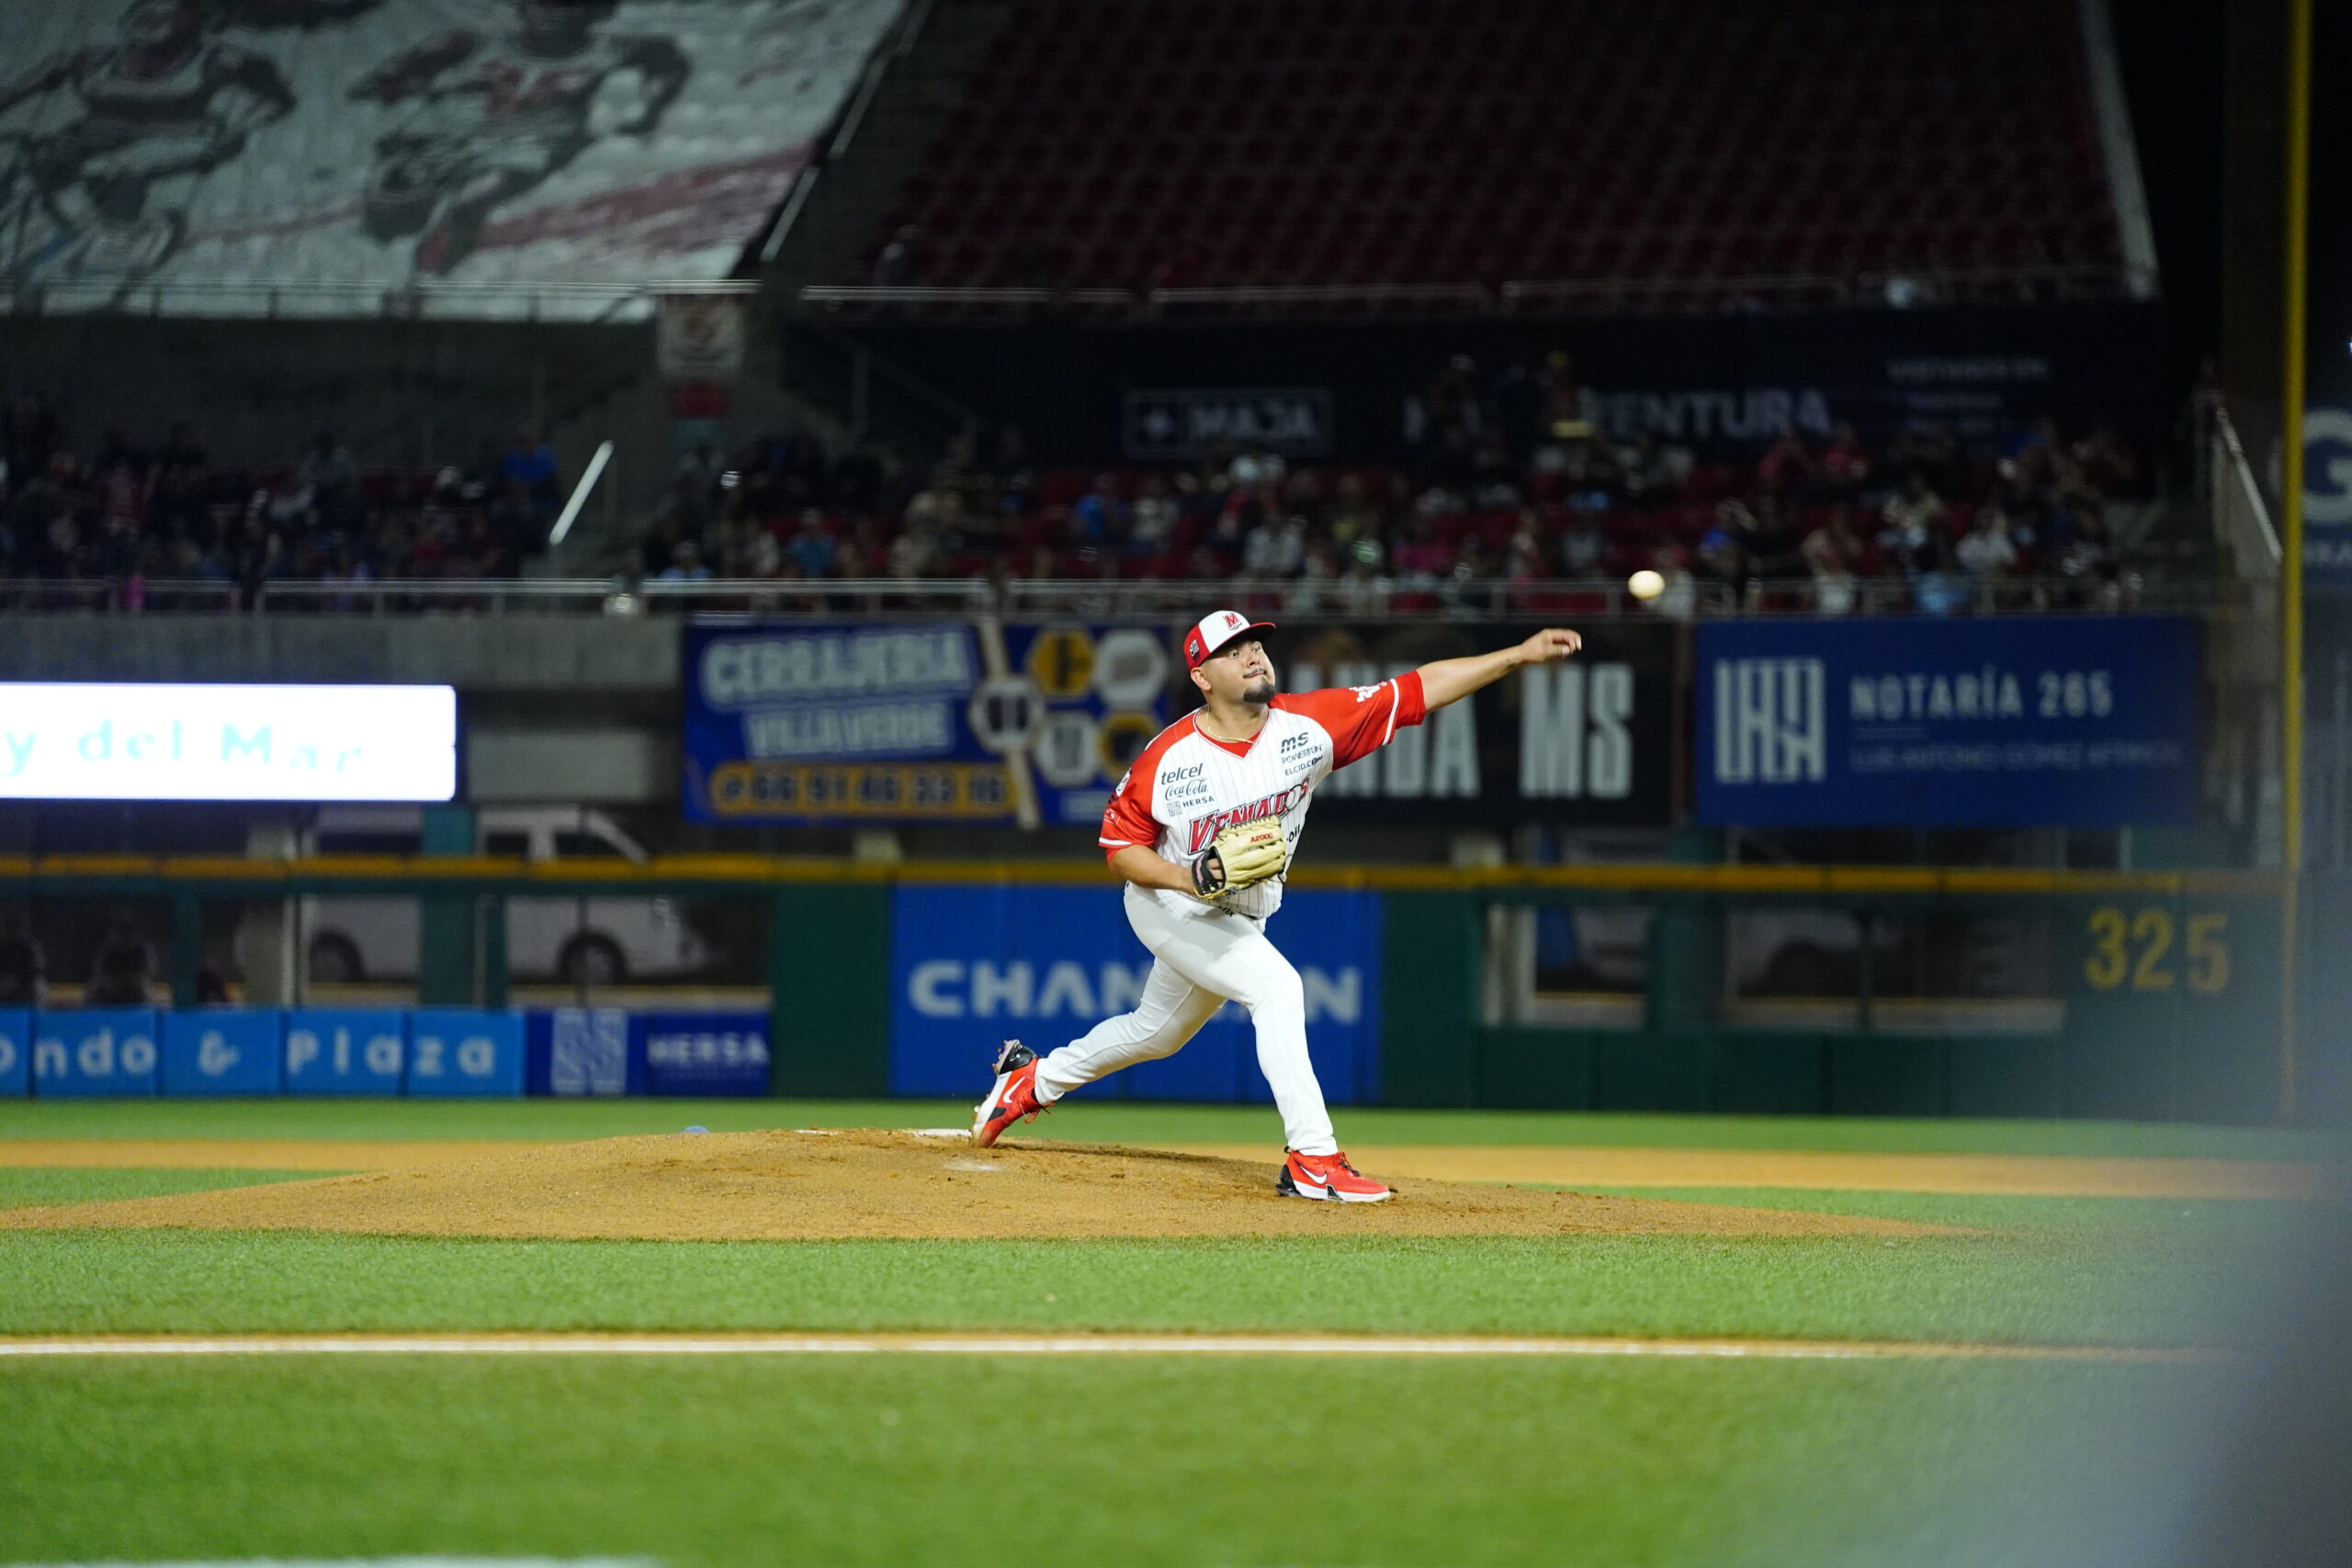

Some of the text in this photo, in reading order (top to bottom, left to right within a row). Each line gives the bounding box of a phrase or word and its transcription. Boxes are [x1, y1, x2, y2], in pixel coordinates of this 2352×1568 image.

[1849, 662, 2024, 720] NOTARÍA
[77, 718, 183, 761] del
[220, 721, 363, 773] Mar
[1521, 662, 1634, 797] MS
[1160, 762, 1204, 785] telcel
[1182, 795, 1215, 808] HERSA
[1187, 774, 1311, 855] VENADOS
[2085, 905, 2231, 995] 325
[909, 959, 1362, 1025] CHAMN
[198, 1029, 241, 1077] &
[287, 1024, 497, 1077] Plaza
[647, 1033, 770, 1067] HERSA
